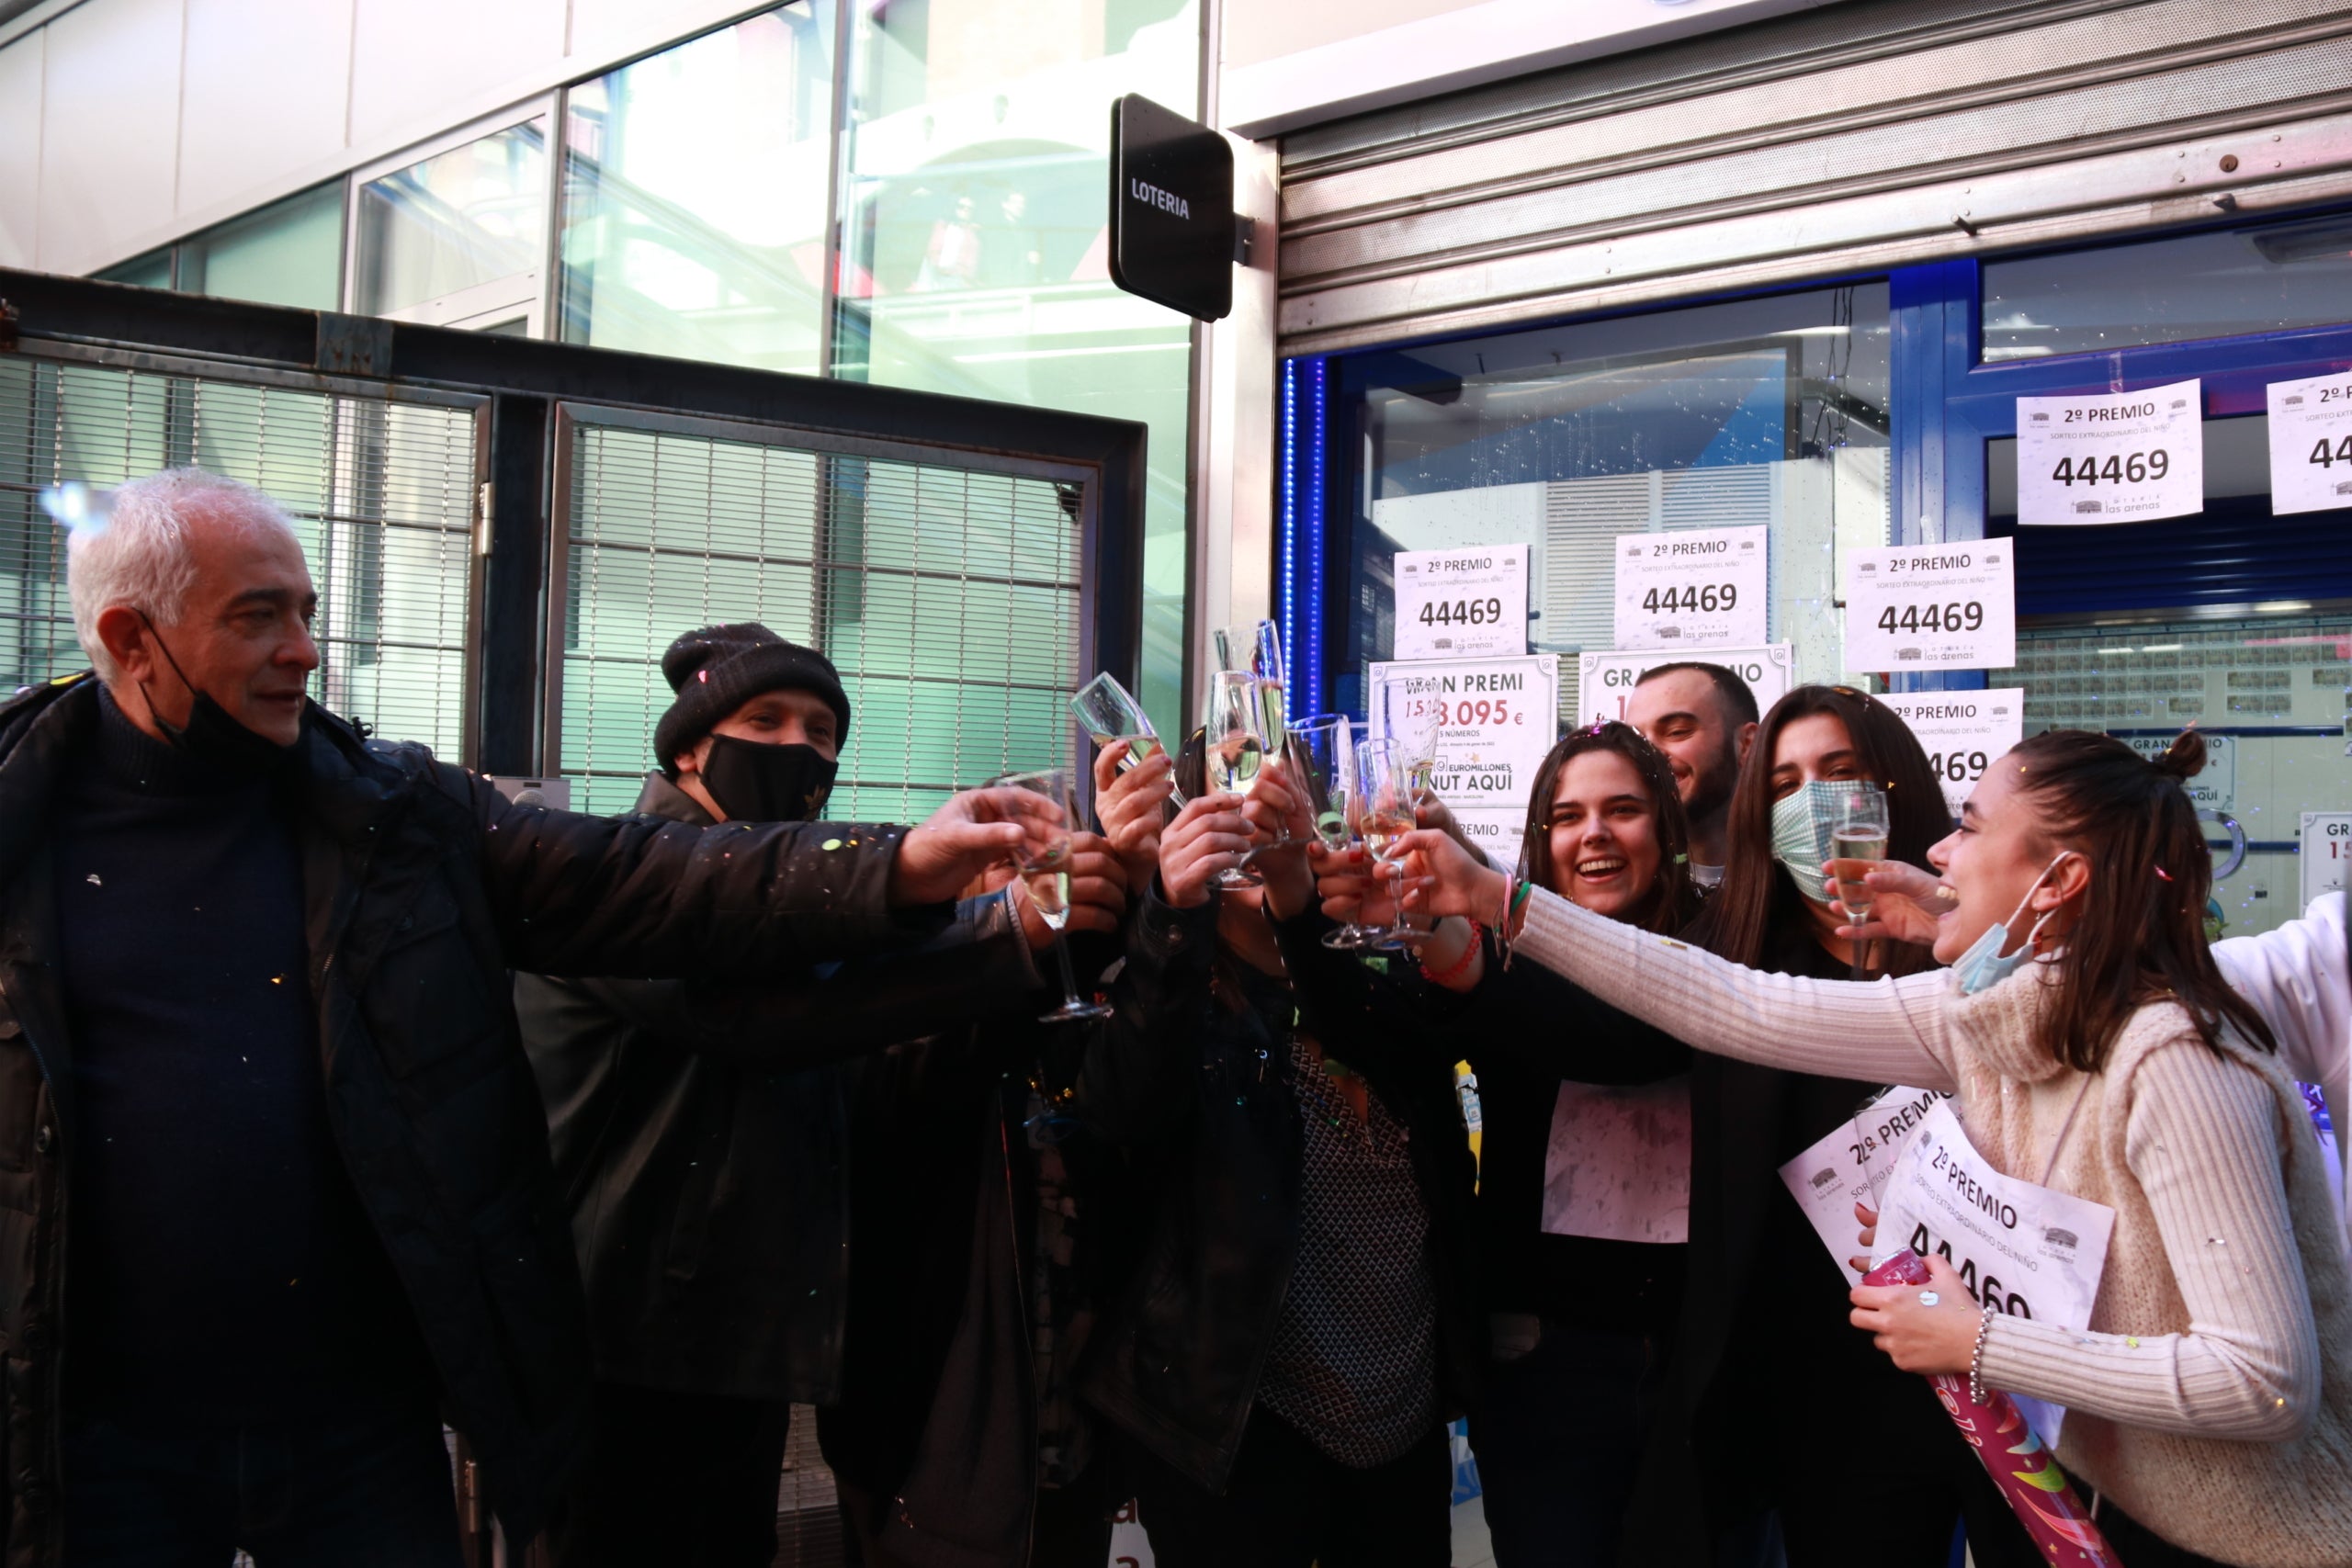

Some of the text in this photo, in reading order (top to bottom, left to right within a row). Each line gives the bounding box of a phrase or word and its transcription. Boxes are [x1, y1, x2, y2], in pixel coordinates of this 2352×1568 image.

[1132, 177, 1190, 220] LOTERIA
[2320, 388, 2340, 403] 2º
[2064, 410, 2083, 423] 2º
[2088, 402, 2155, 422] PREMIO
[2305, 412, 2334, 422] SORTEO
[2079, 428, 2139, 440] EXTRAORDINARIO
[2140, 426, 2152, 434] DEL
[2154, 423, 2171, 432] NIÑO
[2052, 448, 2169, 487] 44469
[2105, 502, 2160, 514] las arenas
[1654, 540, 1727, 557] 2º PREMIO
[1428, 557, 1492, 573] 2º PREMIO
[1641, 565, 1663, 573] SORTEO
[1665, 562, 1713, 571] EXTRAORDINARIO
[1890, 554, 1972, 572] 2º PREMIO
[1903, 578, 1957, 588] EXTRAORDINARIO
[1958, 577, 1968, 585] DEL
[1970, 575, 1985, 584] NIÑO
[1643, 583, 1737, 614] 44469
[1419, 597, 1501, 626] 44469
[1878, 601, 1984, 634] 44469
[1683, 630, 1729, 639] las arenas
[1454, 641, 1494, 650] las arenas
[1925, 650, 1974, 661] las arenas
[1464, 673, 1523, 693] PREMI
[1514, 712, 1523, 726] €
[1916, 705, 1976, 719] PREMIO
[1445, 728, 1480, 738] NÚMEROS
[2133, 739, 2169, 750] GRAN
[1449, 763, 1511, 773] EUROMILLONES
[1467, 771, 1512, 792] AQUÍ
[1931, 1145, 2018, 1230] 2º PREMIO
[1916, 1173, 1936, 1200] SORTEO
[1936, 1194, 1996, 1247] EXTRAORDINARIO
[1997, 1241, 2013, 1258] DEL
[2013, 1251, 2038, 1272] NIÑO
